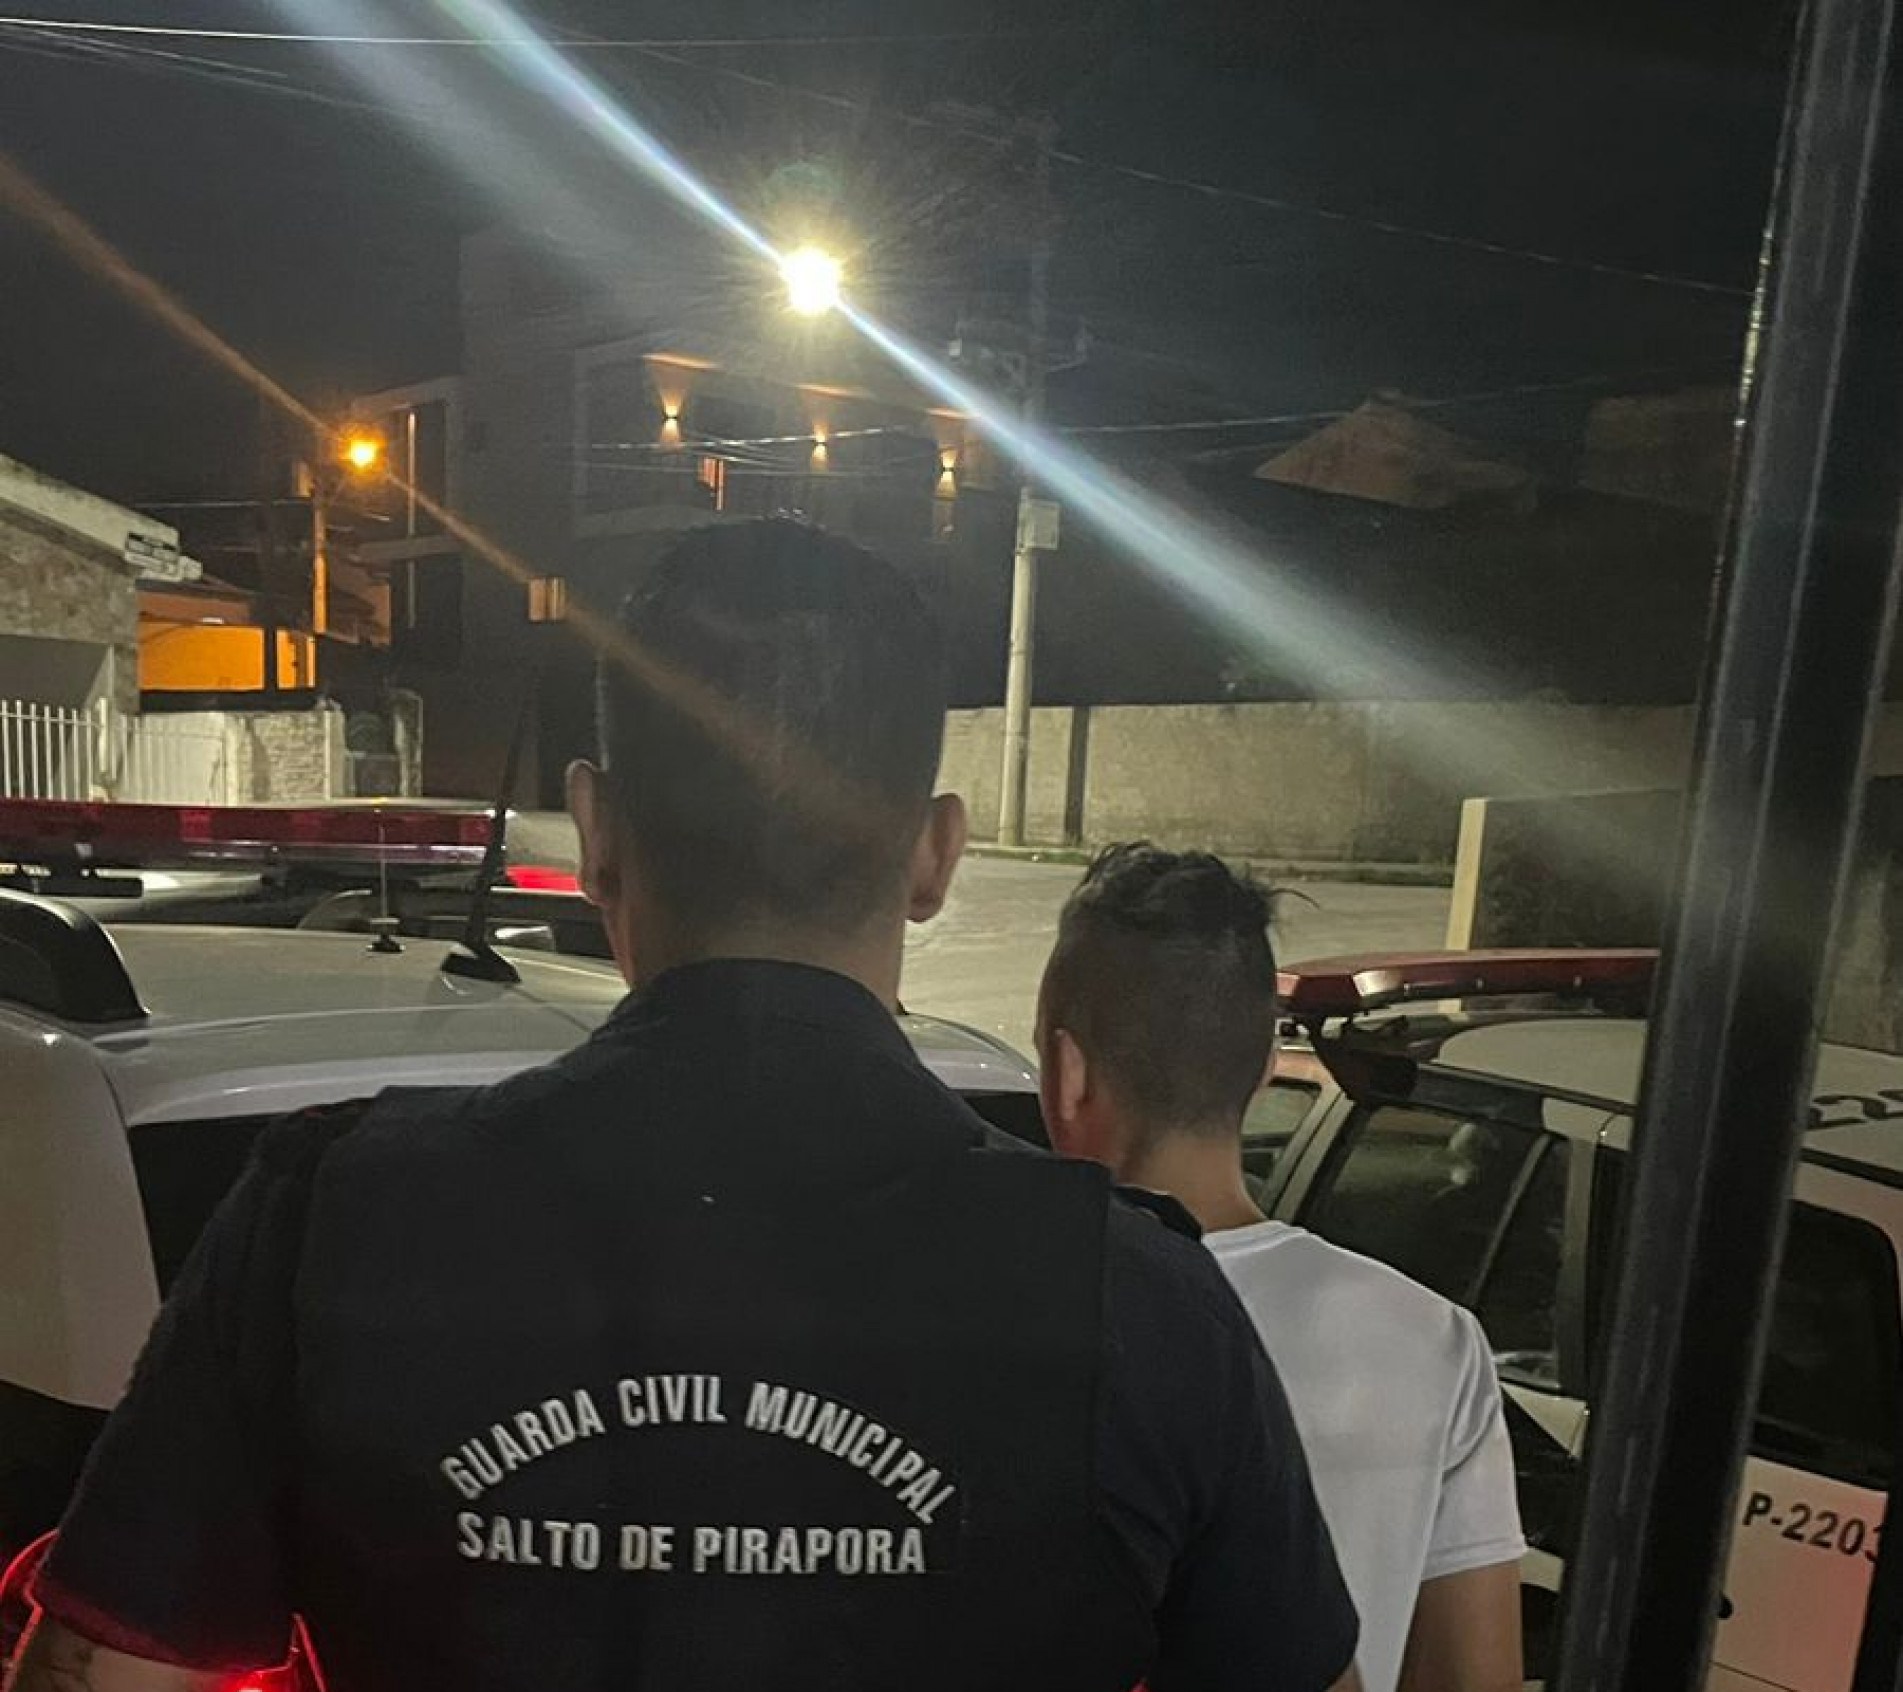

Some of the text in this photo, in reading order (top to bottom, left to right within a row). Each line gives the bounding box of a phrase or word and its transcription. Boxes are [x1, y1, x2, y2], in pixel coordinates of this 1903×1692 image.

[440, 1374, 956, 1525] GUARDA CIVIL MUNICIPAL
[457, 1510, 926, 1575] SALTO DE PIRAPORA
